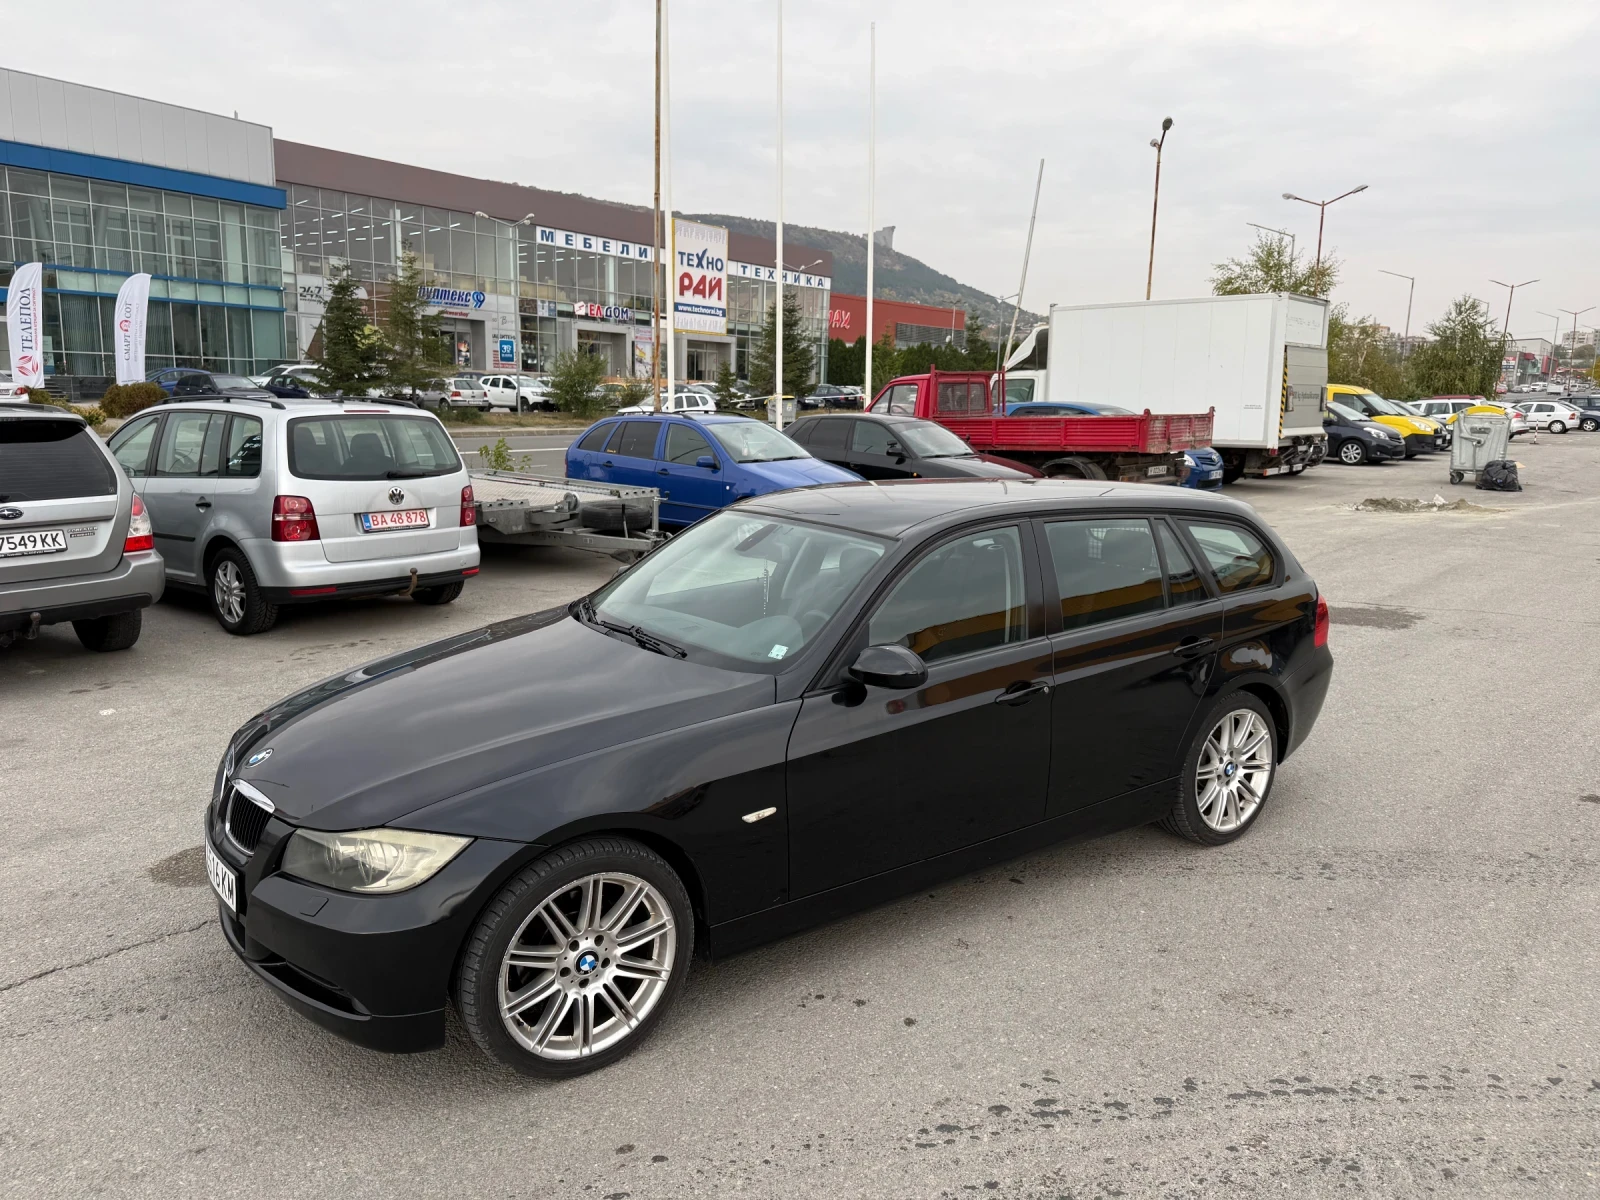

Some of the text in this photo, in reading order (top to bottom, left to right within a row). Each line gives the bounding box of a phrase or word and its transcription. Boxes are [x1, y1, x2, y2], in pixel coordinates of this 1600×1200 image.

[540, 229, 648, 259] МЕБЕЛИ
[678, 248, 724, 272] ТЕХНО
[679, 272, 722, 302] РАЙ
[741, 265, 824, 287] ТЕХНИКА
[19, 287, 33, 353] ТЕЛЕПОЛ
[124, 302, 132, 319] СОТ
[677, 305, 723, 317] www.technorai.bg
[371, 511, 426, 526] BA 48 878
